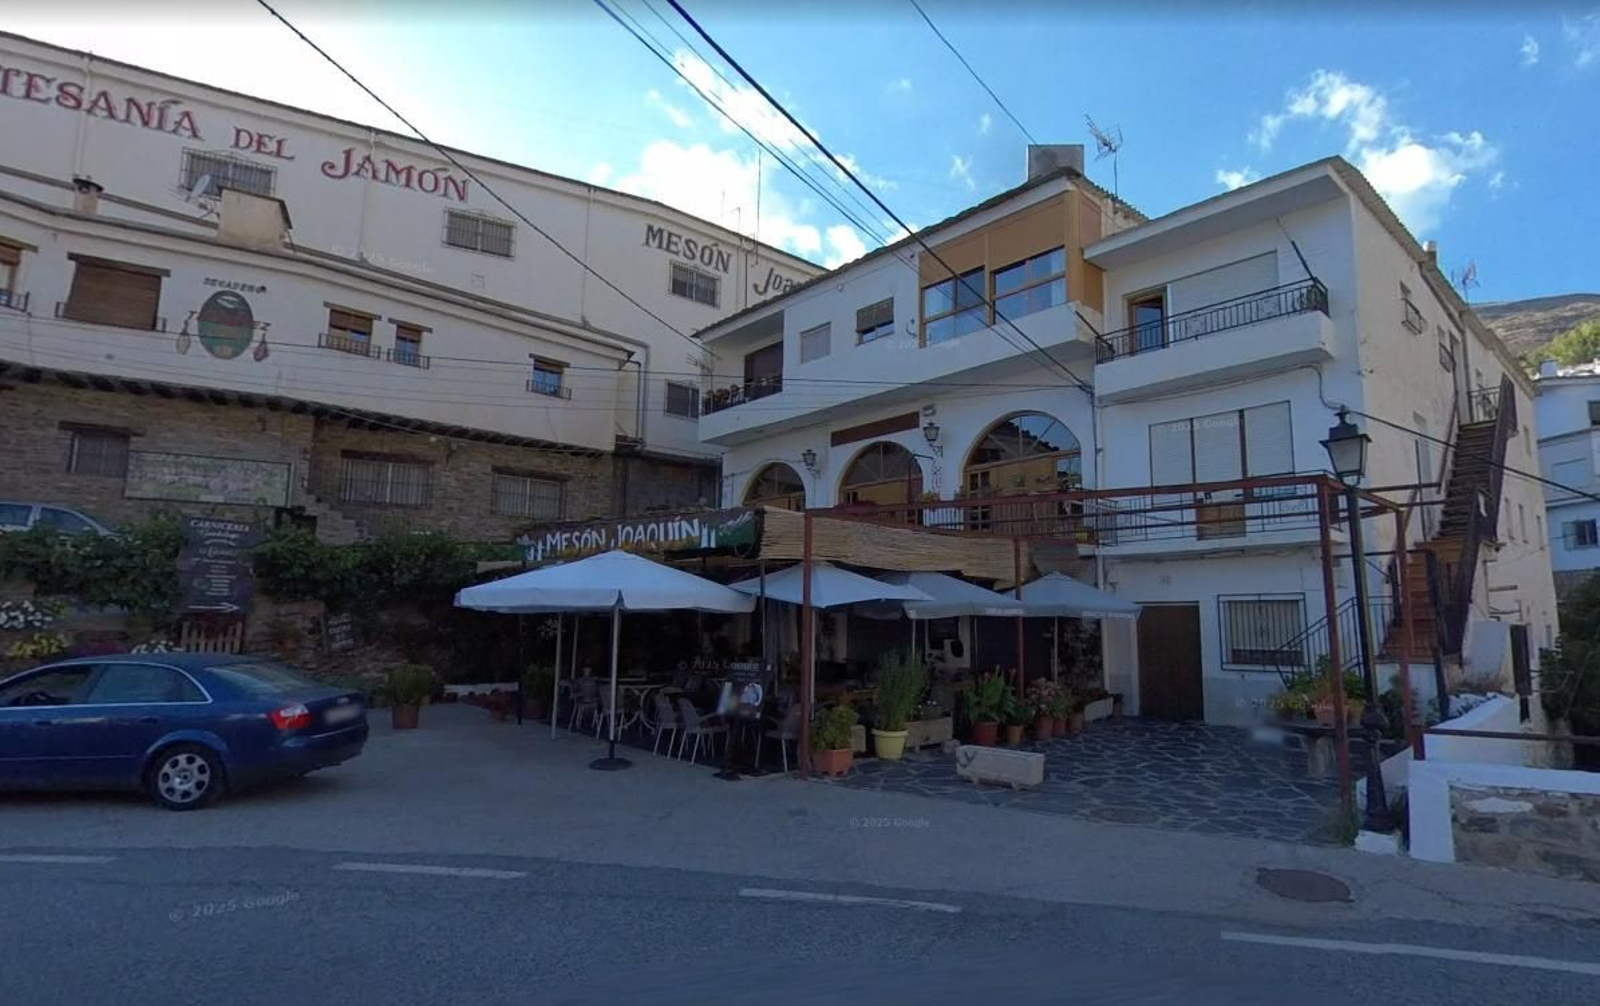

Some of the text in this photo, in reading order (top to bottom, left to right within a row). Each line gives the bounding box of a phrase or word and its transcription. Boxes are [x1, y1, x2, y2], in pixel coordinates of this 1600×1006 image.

[230, 126, 295, 161] DEL
[320, 148, 470, 203] JAMÓN
[643, 224, 732, 273] MESÓN
